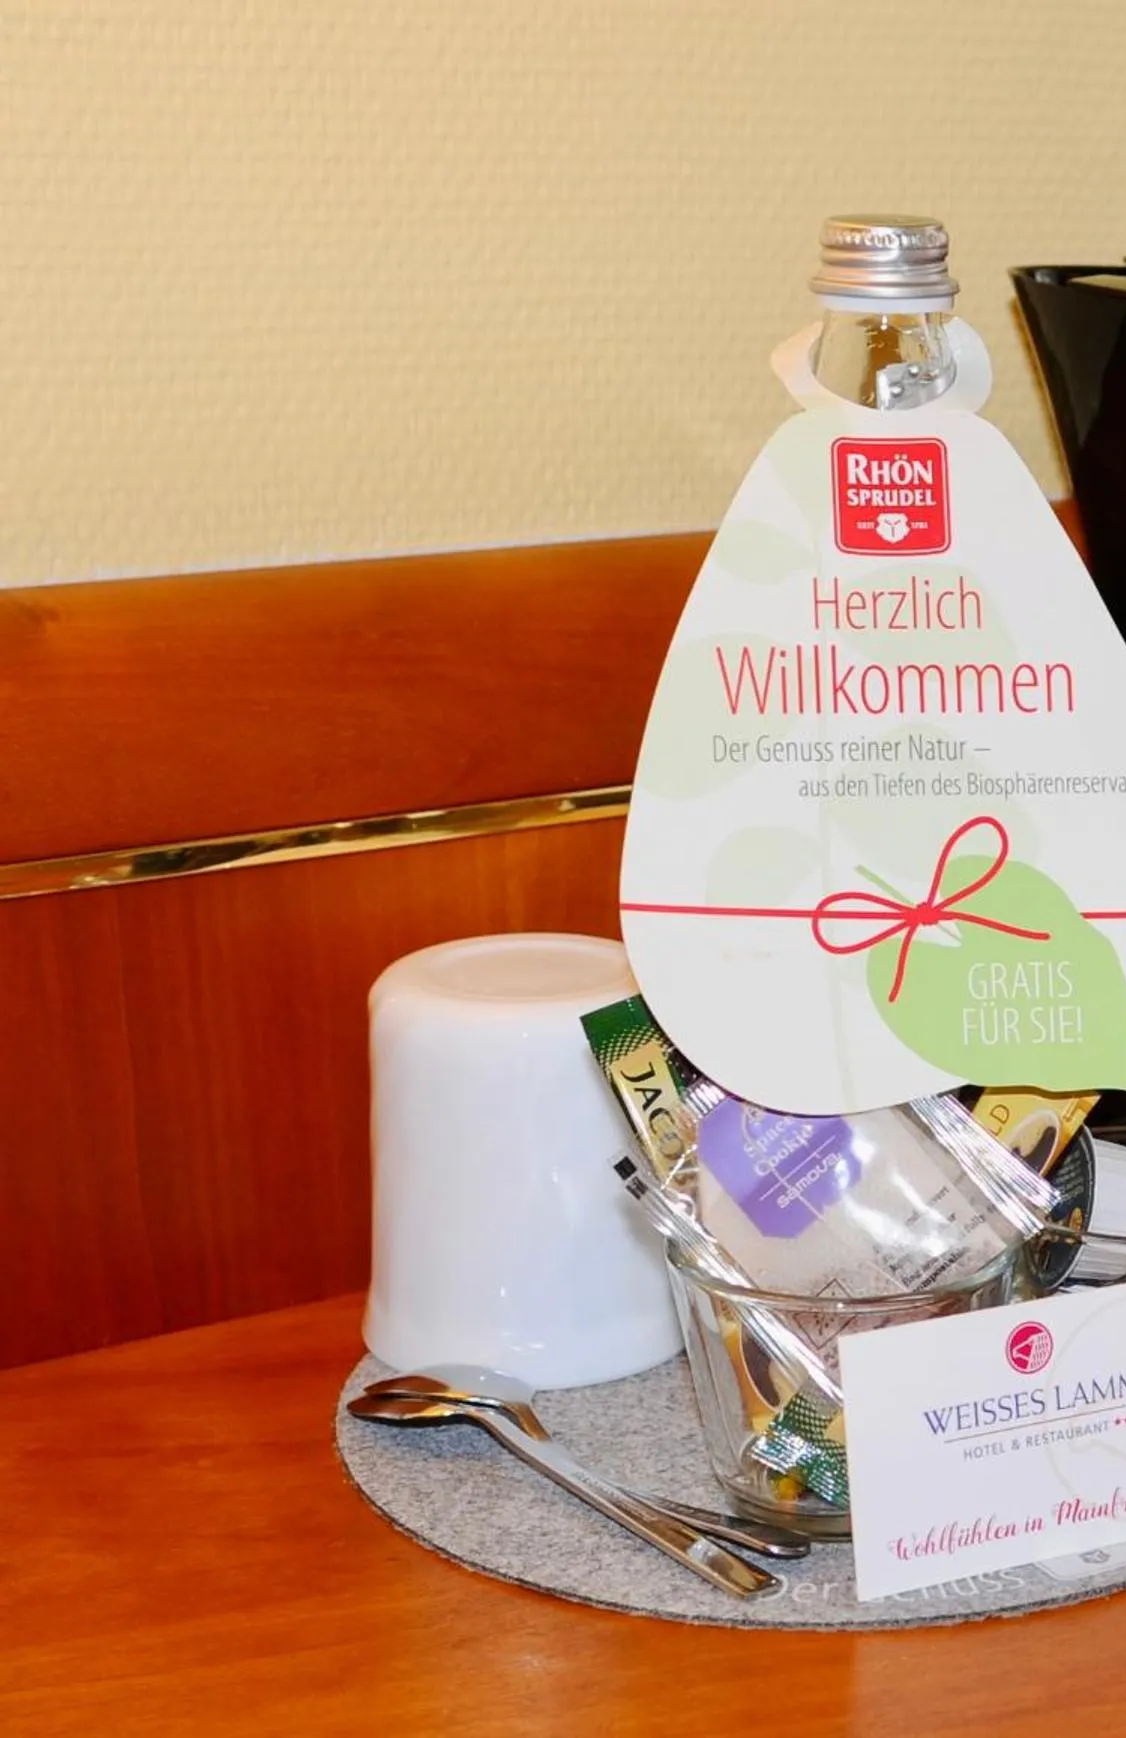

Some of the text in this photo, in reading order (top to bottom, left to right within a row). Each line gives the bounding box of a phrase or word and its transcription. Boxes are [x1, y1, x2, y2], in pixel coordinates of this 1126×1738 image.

[846, 453, 934, 486] RHÖN
[846, 488, 937, 507] SPRUDEL
[812, 575, 983, 631] Herzlich
[715, 644, 1076, 715] Willkommen
[712, 734, 749, 763] Der
[757, 734, 834, 763] Genuss
[841, 735, 901, 762] reiner
[908, 733, 967, 761] Natur
[798, 777, 830, 797] aus
[834, 773, 868, 797] den
[874, 772, 926, 796] Tiefen
[931, 772, 962, 796] des
[967, 960, 1074, 1001] GRATIS
[962, 1001, 1084, 1046] FÜR SIE!
[923, 1388, 1046, 1436] WEISSES
[963, 1420, 1110, 1461] HOTEL & RESTAURANT
[889, 1514, 1017, 1562] Wohlfühlen
[1024, 1515, 1045, 1534] in
